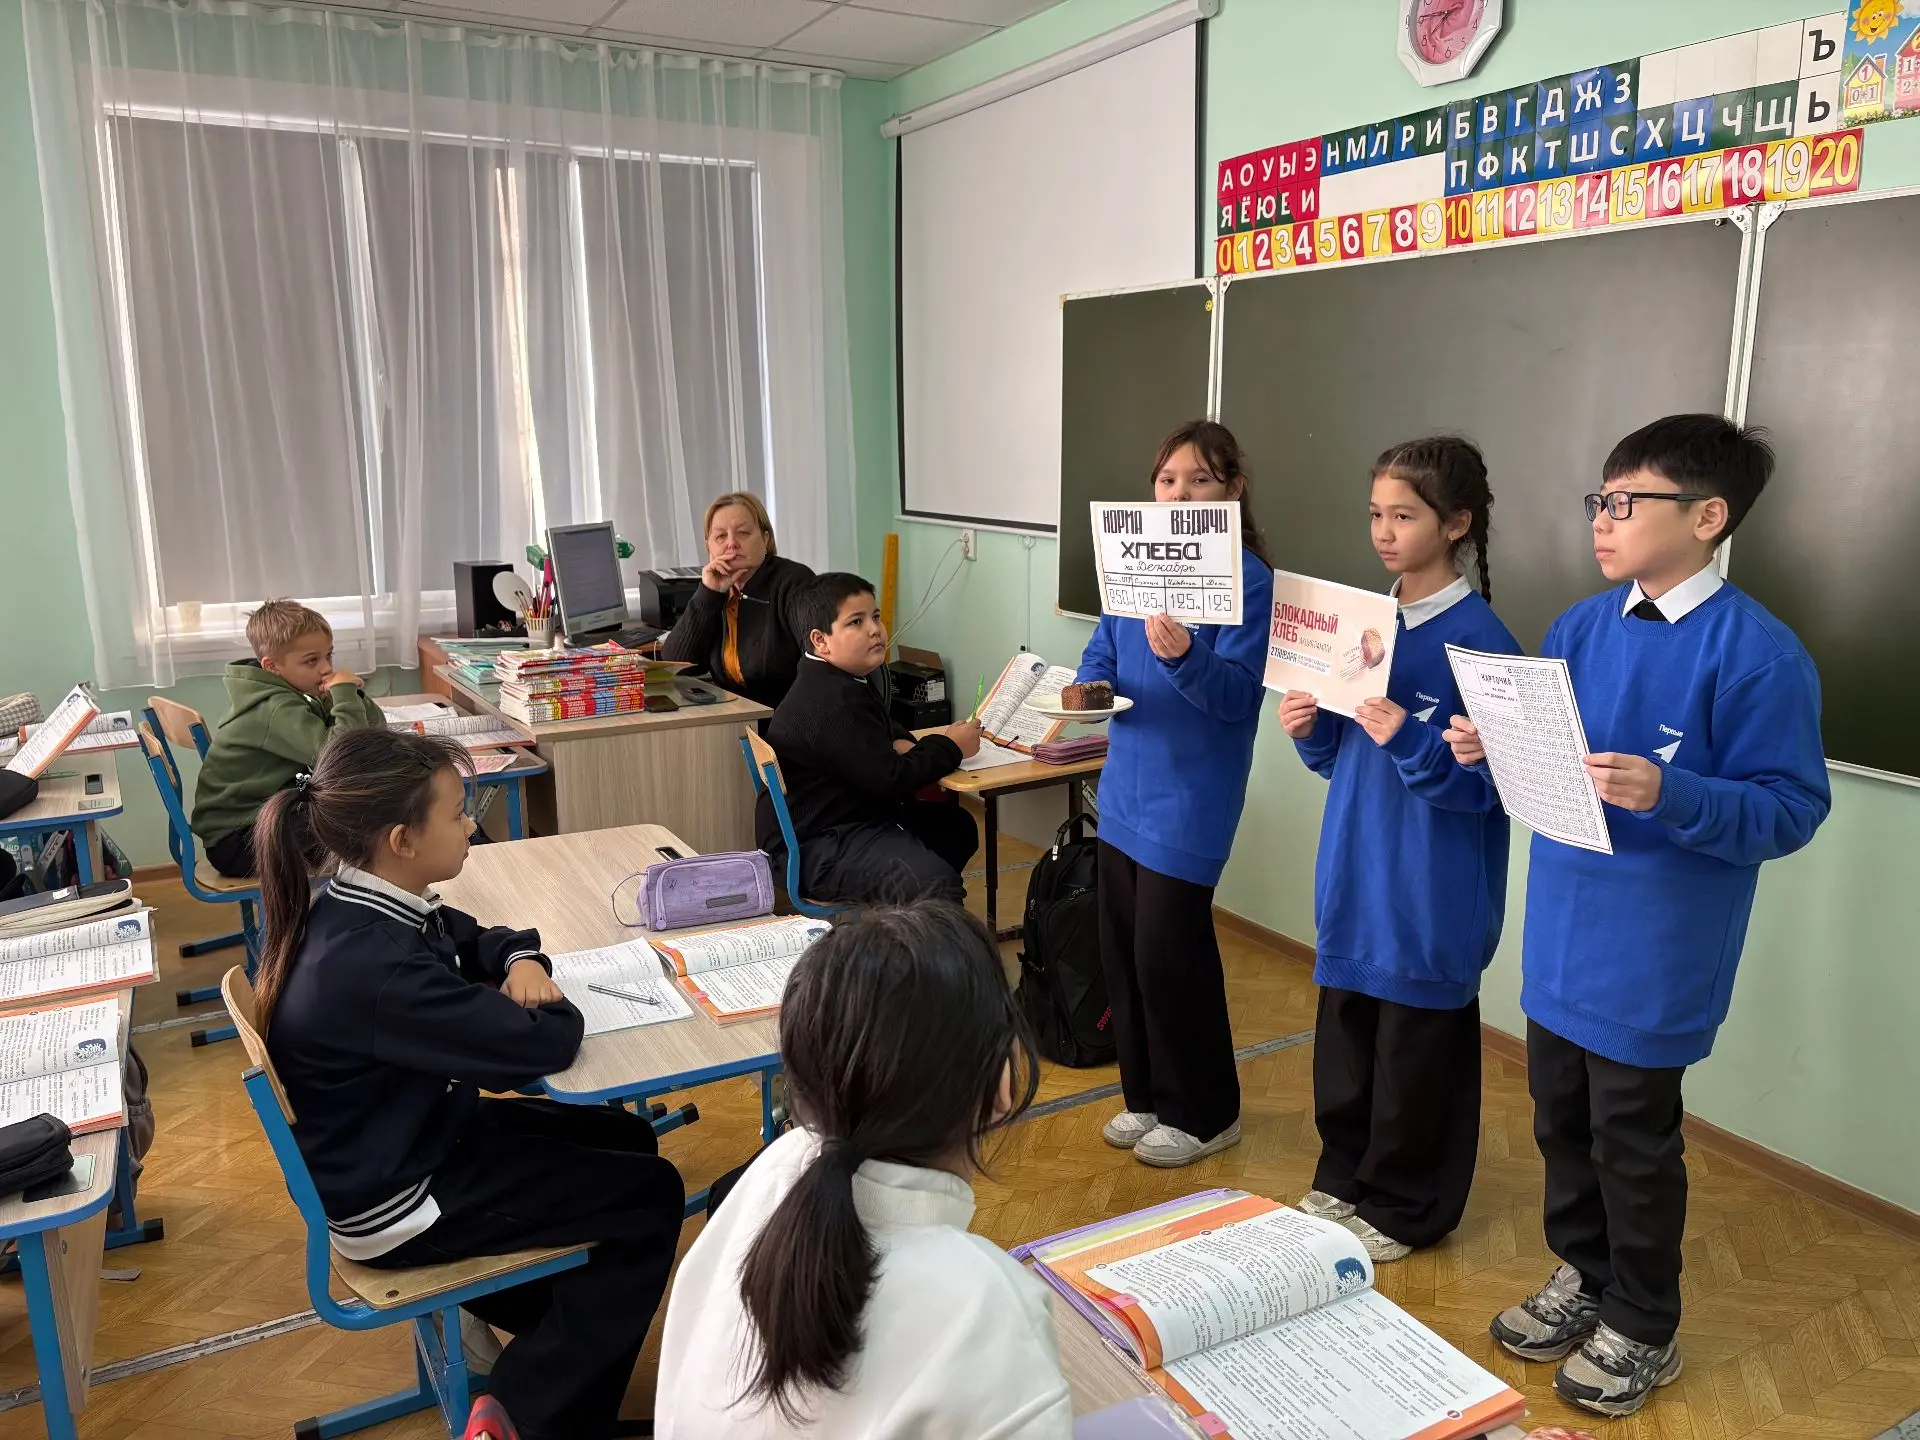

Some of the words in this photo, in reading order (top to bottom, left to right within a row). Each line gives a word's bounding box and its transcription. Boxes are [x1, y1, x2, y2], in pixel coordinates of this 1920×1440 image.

[1422, 34, 1428, 46] 8
[1460, 37, 1466, 50] 5
[1432, 45, 1437, 58] 7
[1444, 46, 1452, 58] 6
[1862, 65, 1869, 80] 1
[1852, 86, 1877, 102] 0+1
[1219, 239, 1231, 271] 0
[1237, 237, 1249, 269] 1
[1255, 233, 1271, 267] 2
[1275, 229, 1292, 264] 3
[1295, 226, 1312, 260] 4
[1319, 221, 1337, 259] 5
[1342, 218, 1360, 254] 6
[1367, 214, 1386, 252] 7
[1394, 209, 1414, 247] 8
[1421, 203, 1443, 243] 9
[1446, 198, 1471, 240] 10
[1475, 194, 1499, 236] 11
[1506, 187, 1536, 232] 12
[1539, 181, 1572, 227] 13
[1576, 175, 1608, 222] 14
[1612, 168, 1646, 216] 15
[1646, 163, 1681, 211] 16
[1683, 155, 1722, 206] 17
[1724, 149, 1763, 199] 18
[1768, 142, 1810, 193] 19
[1811, 135, 1858, 189] 20
[1102, 510, 1142, 534] НОРМА
[1170, 508, 1228, 536] ВЫДАЧИ
[1136, 560, 1196, 575] Декабрь
[1138, 592, 1158, 608] 125
[1171, 594, 1194, 609] 125
[1208, 594, 1232, 611] 125
[1274, 602, 1338, 634] БЛОКАДНЫЙ
[1272, 620, 1298, 642] ХЛЕБ
[1659, 724, 1683, 737] Первые
